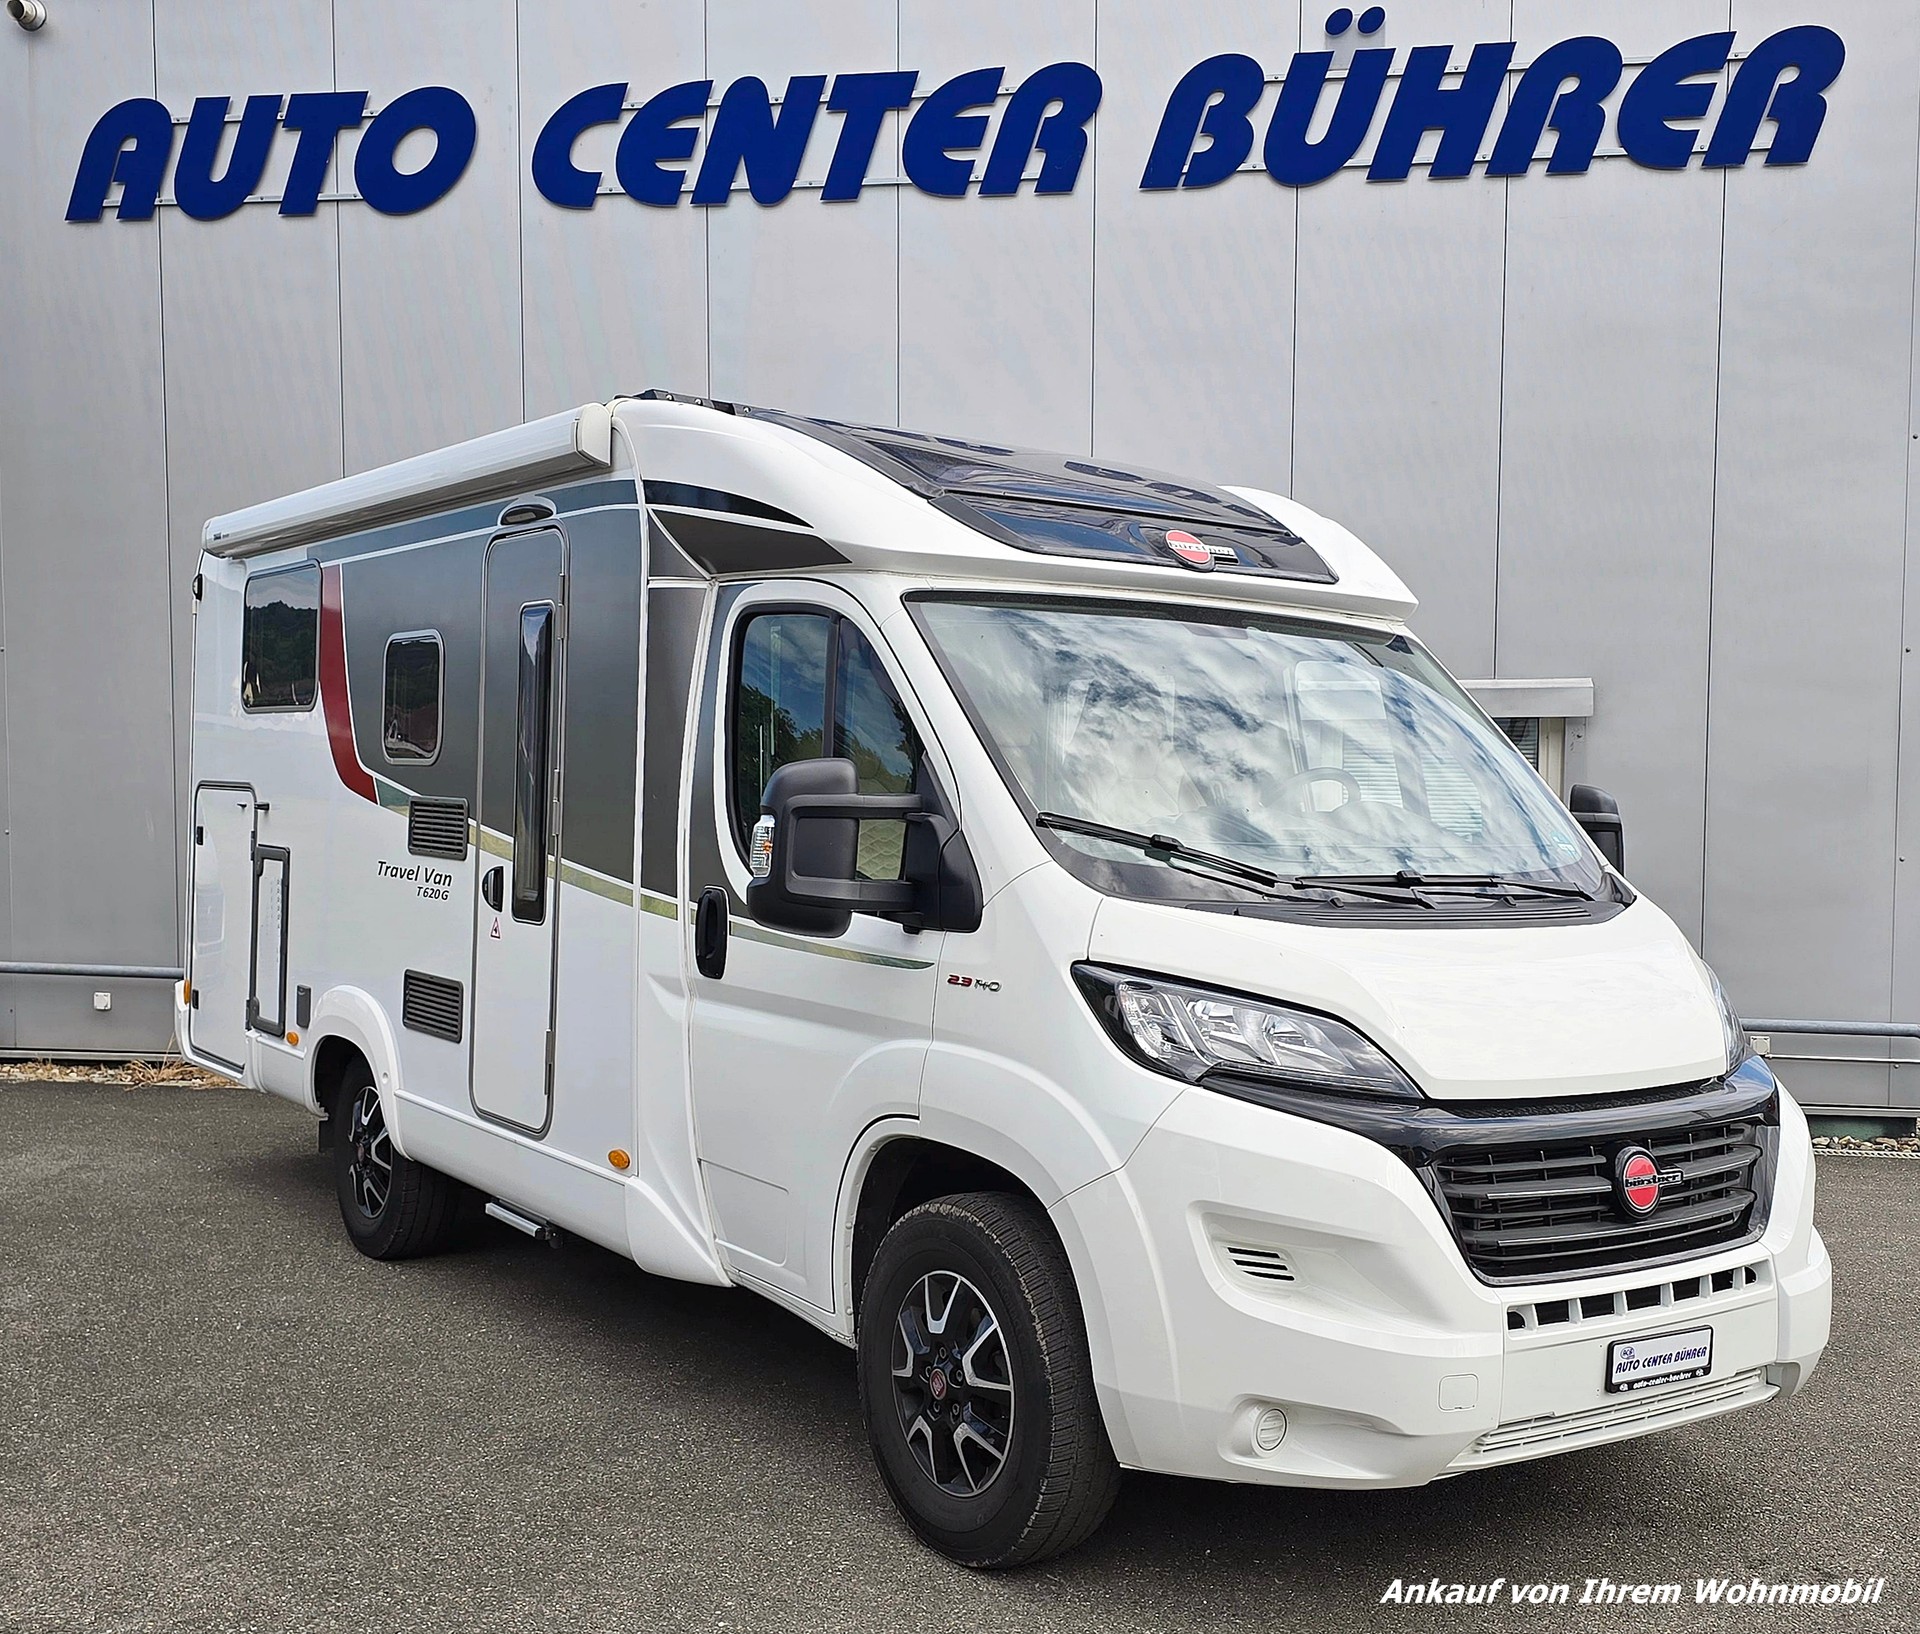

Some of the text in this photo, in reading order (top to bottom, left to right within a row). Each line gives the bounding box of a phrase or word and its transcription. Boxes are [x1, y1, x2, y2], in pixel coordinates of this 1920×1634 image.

[66, 8, 1845, 220] AUTO CENTER BÜHRER
[378, 861, 452, 886] Travel Van
[1615, 1346, 1708, 1374] AUTO CENTER BÜHRER
